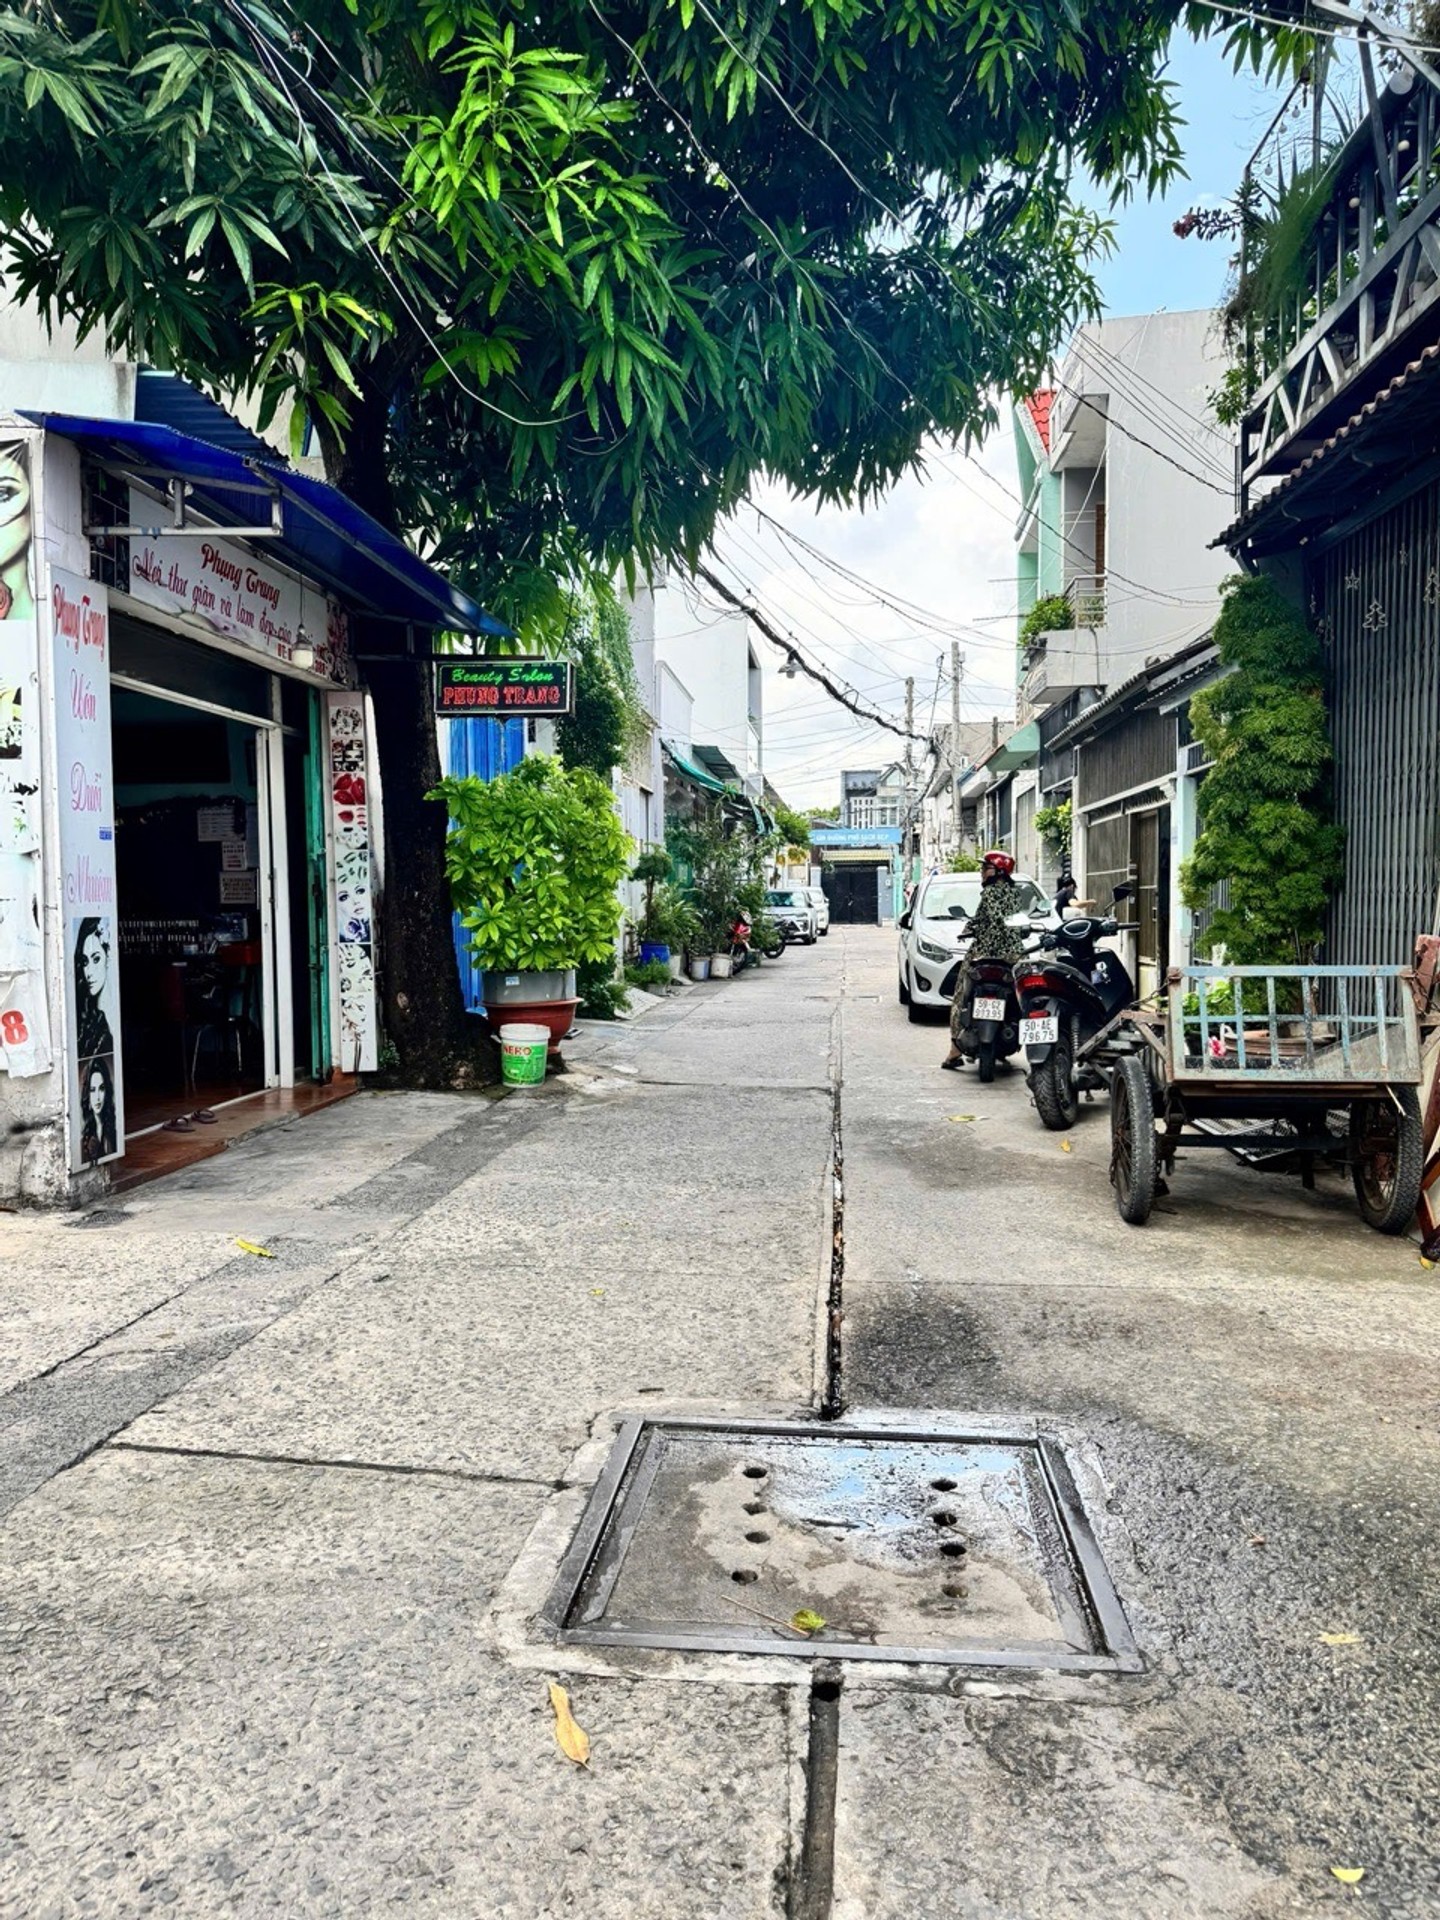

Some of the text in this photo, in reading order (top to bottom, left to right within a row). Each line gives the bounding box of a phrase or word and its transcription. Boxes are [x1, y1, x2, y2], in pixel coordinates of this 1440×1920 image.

[168, 563, 189, 598] thư
[192, 579, 216, 615] giãn
[220, 595, 232, 618] và
[236, 593, 255, 630] làm
[201, 543, 281, 610] Phụng Trang
[452, 667, 554, 686] Beauty Salon
[503, 685, 560, 705] TRANG
